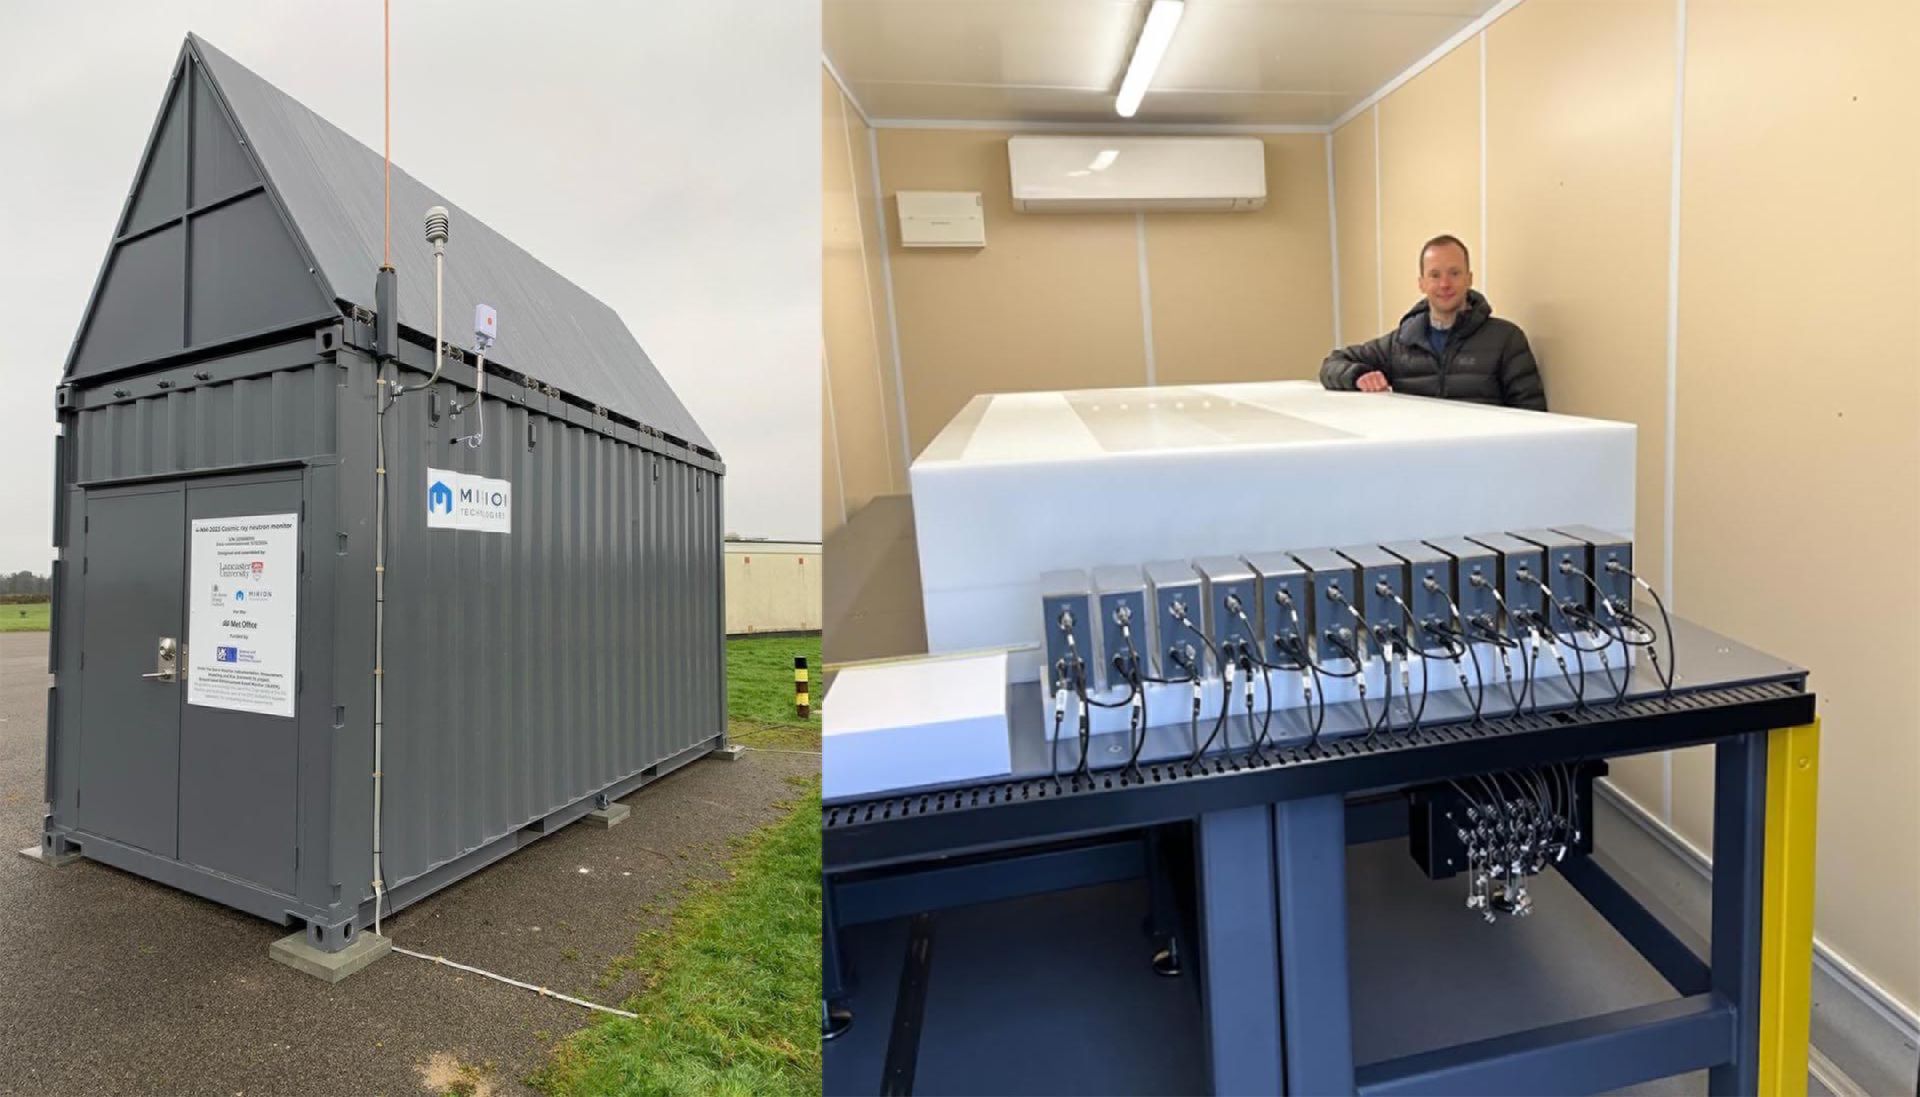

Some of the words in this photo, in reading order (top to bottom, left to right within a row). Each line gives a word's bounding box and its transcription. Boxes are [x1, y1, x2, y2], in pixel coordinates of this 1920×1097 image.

[220, 562, 251, 570] Lancaster
[219, 570, 250, 579] University
[231, 620, 241, 629] Met
[241, 620, 257, 629] Office
